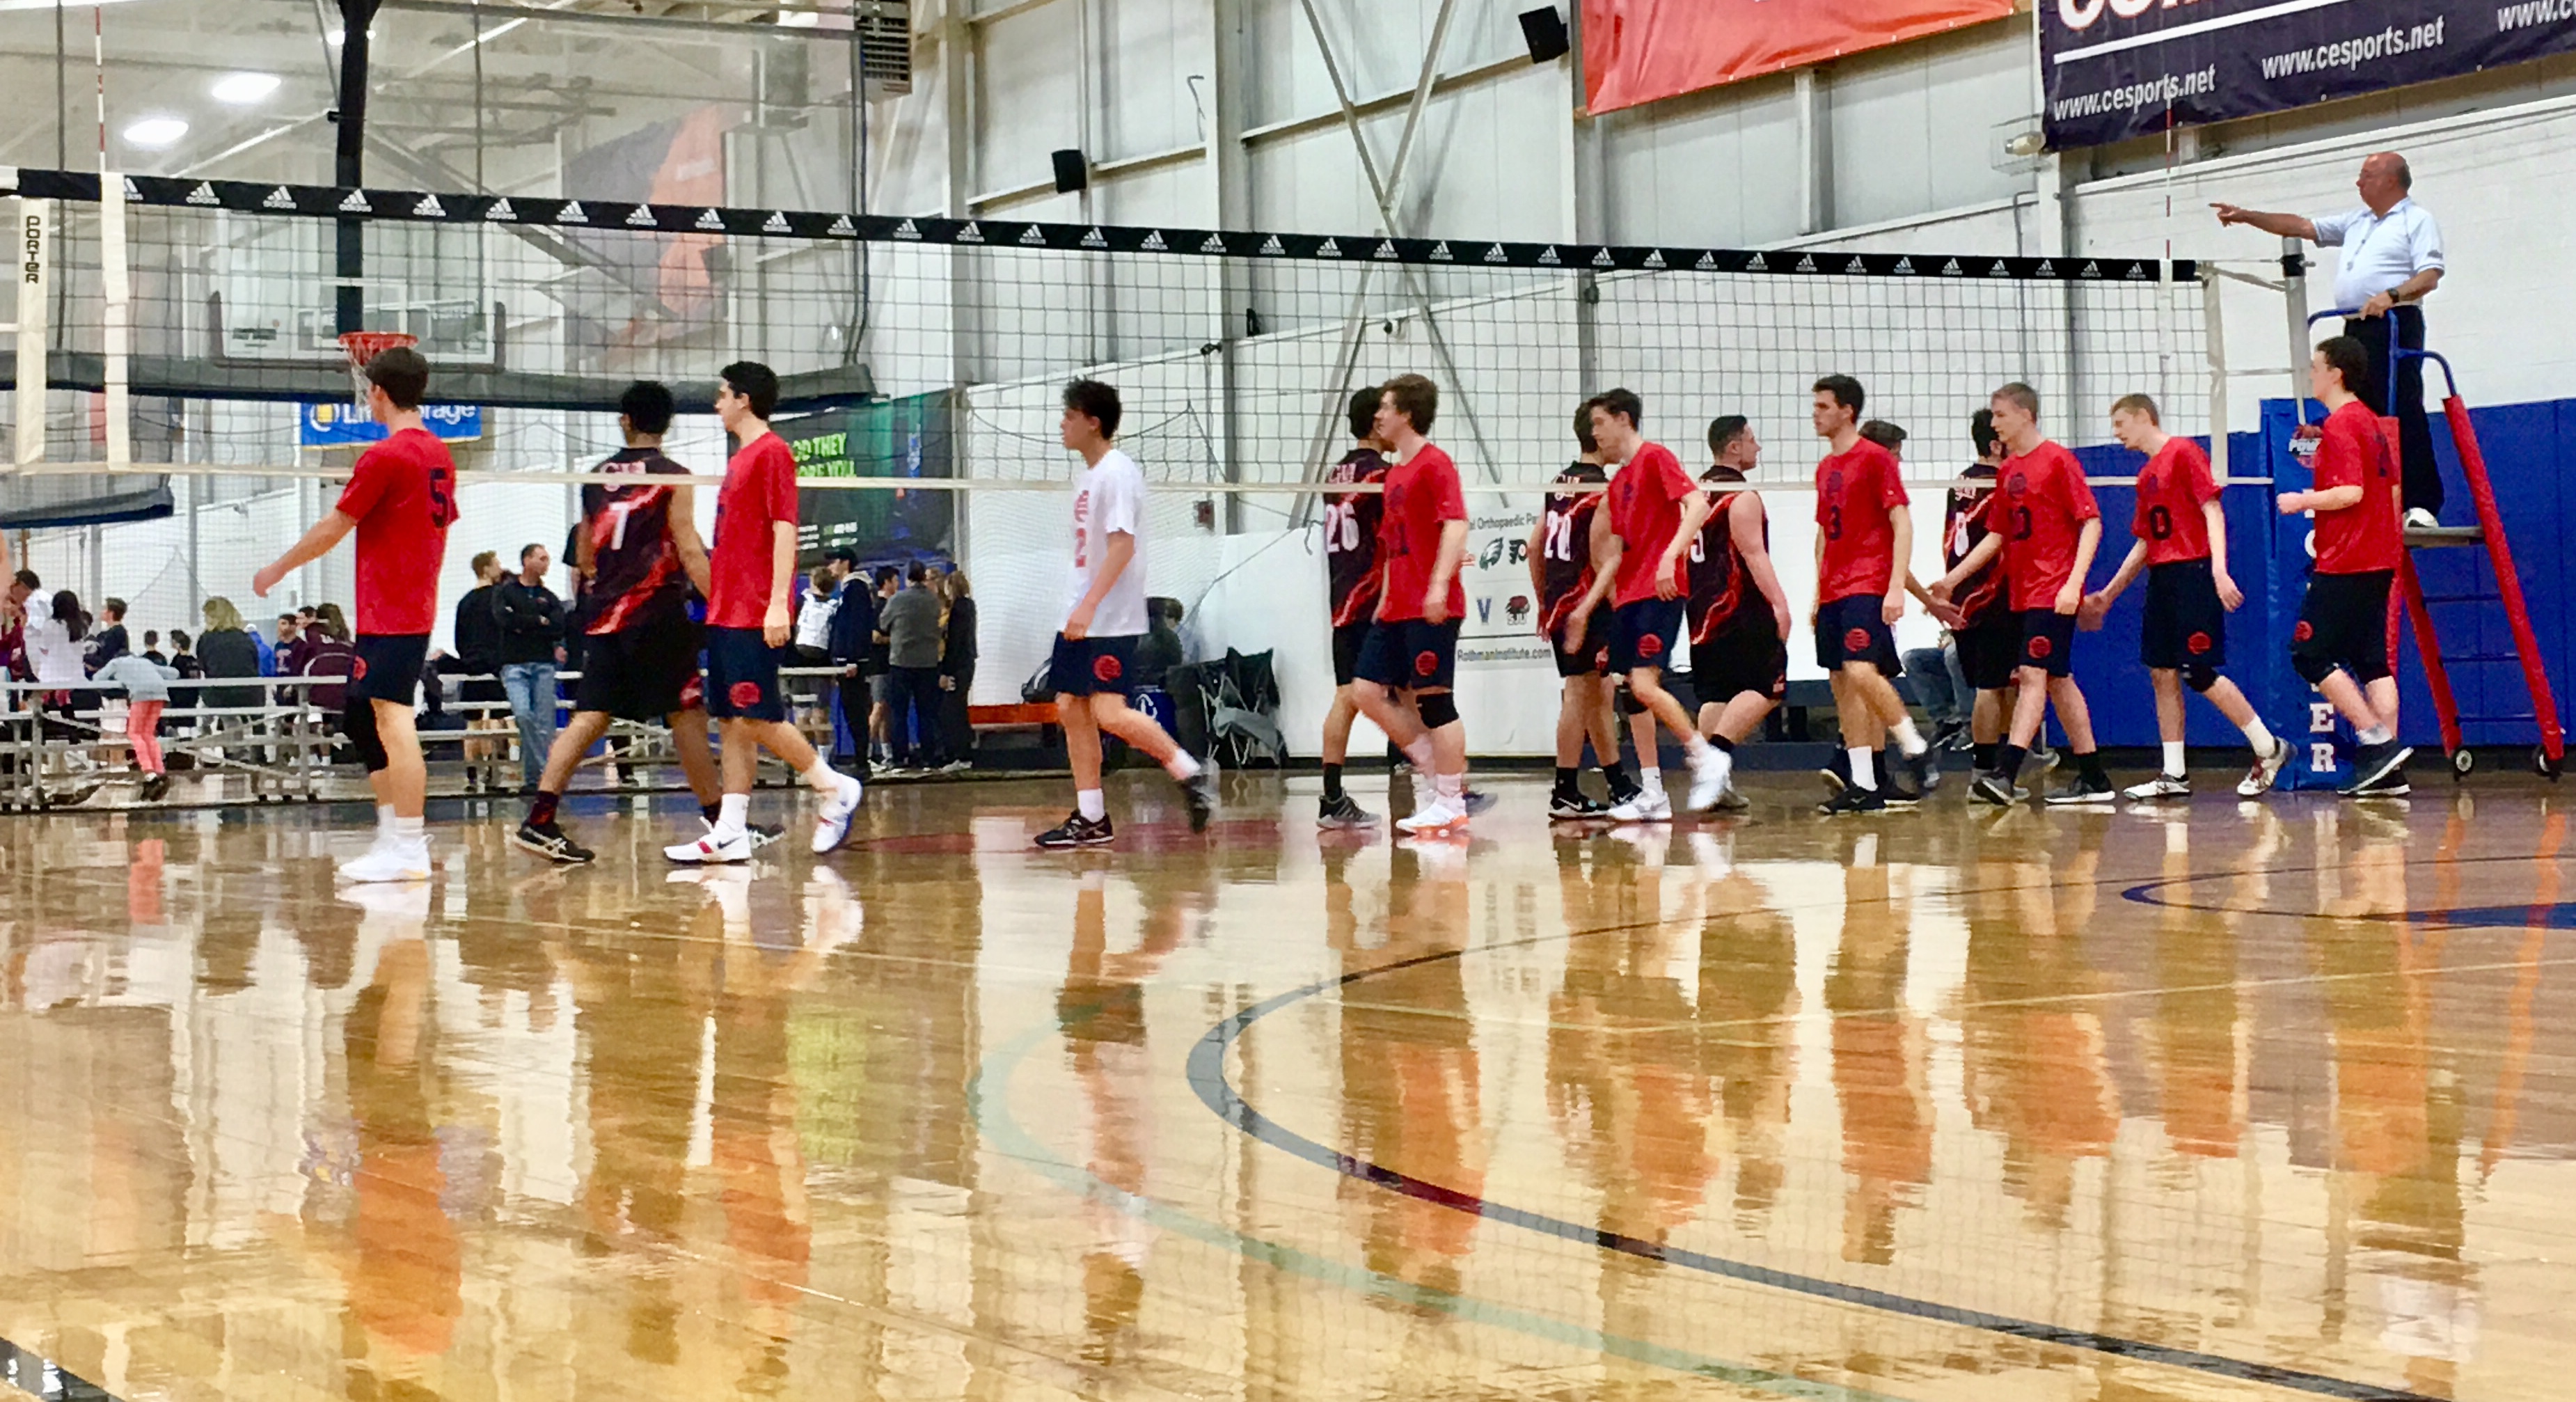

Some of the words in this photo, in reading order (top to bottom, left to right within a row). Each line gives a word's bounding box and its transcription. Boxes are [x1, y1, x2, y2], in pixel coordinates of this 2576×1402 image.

[2262, 15, 2444, 80] www.cesports.net
[2054, 63, 2215, 121] www.cesports.net
[25, 215, 40, 284] PORTER
[812, 432, 846, 457] THEY
[429, 467, 449, 528] 5
[2149, 505, 2173, 540] 0
[608, 501, 630, 551] 7
[1325, 501, 1359, 551] 26
[1544, 509, 1572, 561] 20
